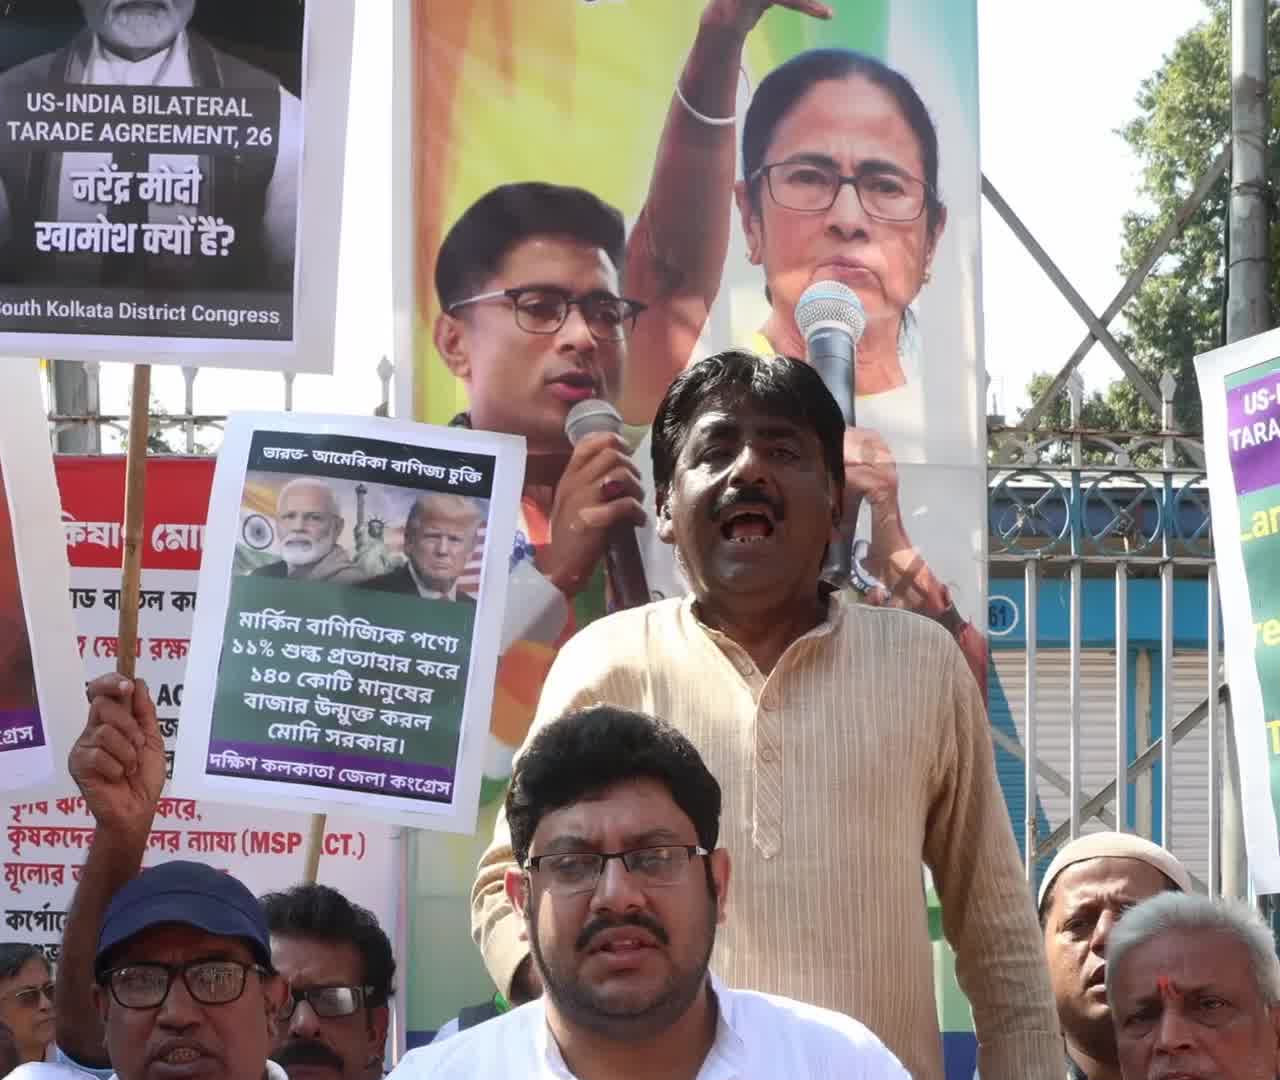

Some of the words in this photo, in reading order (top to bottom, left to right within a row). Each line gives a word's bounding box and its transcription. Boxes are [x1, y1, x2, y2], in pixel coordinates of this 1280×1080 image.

[26, 92, 127, 115] US-INDIA
[132, 95, 253, 118] BILATERAL
[7, 121, 94, 142] TARADE
[98, 123, 240, 149] AGREEMENT,
[245, 126, 273, 147] 26
[69, 163, 133, 206] नरेंद्र
[137, 165, 203, 204] मोदी
[34, 214, 137, 256] खामोश
[142, 216, 198, 255] क्यों
[198, 214, 236, 257] हैं?
[46, 300, 114, 320] Kolkata
[119, 303, 187, 322] District
[191, 305, 281, 326] Congress
[312, 448, 387, 471] আমেরিকা
[392, 456, 446, 480] বাণিজ্য
[449, 465, 483, 485] চুক্তি
[239, 607, 302, 632] মার্কিন
[306, 618, 405, 645] বাণিজ্যিক
[410, 630, 460, 655] পণ্যে
[231, 638, 276, 659] ১১%
[326, 645, 411, 675] প্রত্যাহার
[416, 660, 460, 682] করে
[250, 667, 290, 685] ১৪০
[296, 666, 355, 693] কোটি
[358, 677, 434, 706] মানুষের
[243, 692, 307, 714] বাজার
[380, 710, 433, 732] করল
[267, 718, 322, 745] মোদি
[209, 751, 258, 773] দক্ষিণ
[261, 758, 336, 780] কলকাতা
[338, 765, 387, 787] জেলা
[390, 773, 453, 797] কংগ্রেস
[242, 829, 303, 857] (MSP
[320, 831, 367, 860] CT.)
